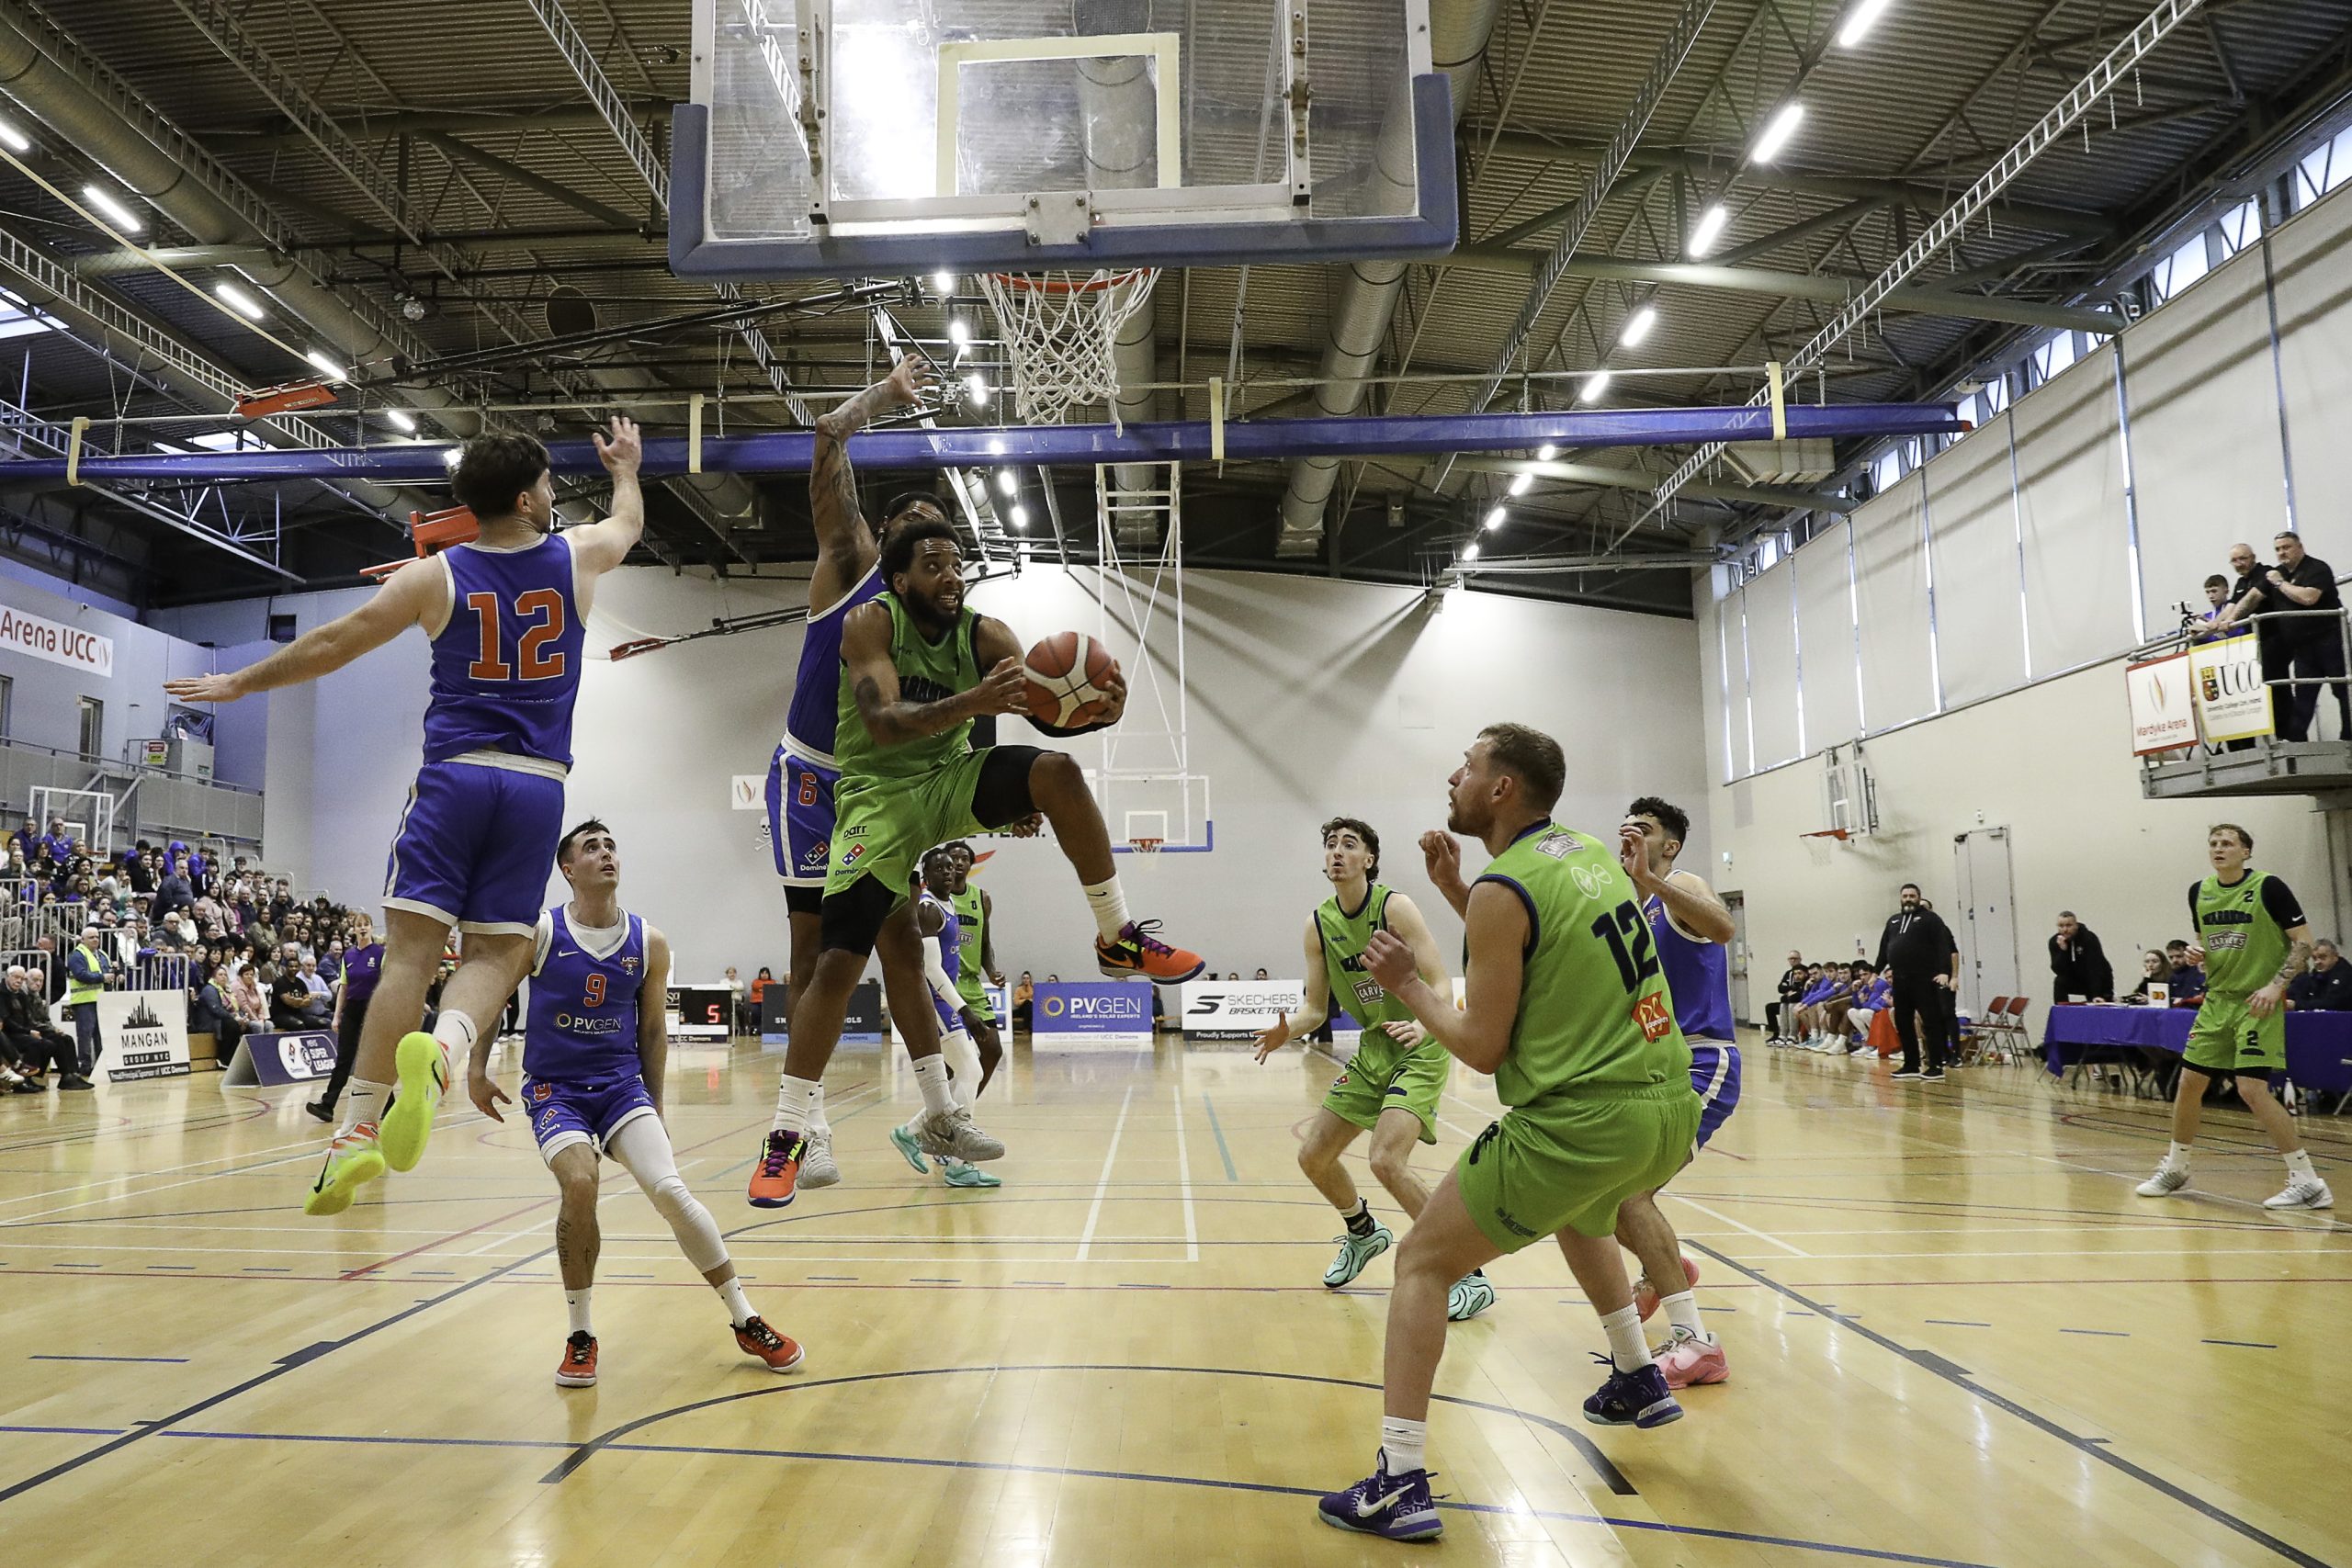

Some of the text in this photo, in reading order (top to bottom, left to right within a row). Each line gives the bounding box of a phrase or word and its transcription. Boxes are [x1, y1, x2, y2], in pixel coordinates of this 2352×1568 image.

[0, 610, 96, 663] Arena UCC
[467, 587, 565, 682] 12
[2220, 659, 2261, 696] UCC
[797, 773, 818, 807] 6
[2245, 890, 2255, 903] 2
[1590, 899, 1660, 995] 12
[582, 973, 607, 1008] 9
[1070, 998, 1141, 1014] PVGEN
[1227, 994, 1298, 1006] SKECHERS
[707, 1004, 721, 1024] 5
[574, 1017, 622, 1031] PVGEN
[121, 1032, 168, 1048] MANGAN
[1196, 1032, 1219, 1040] Proudly
[2246, 1030, 2258, 1046] 2
[124, 1054, 170, 1066] GROUP NYC
[310, 1048, 328, 1059] SUPER
